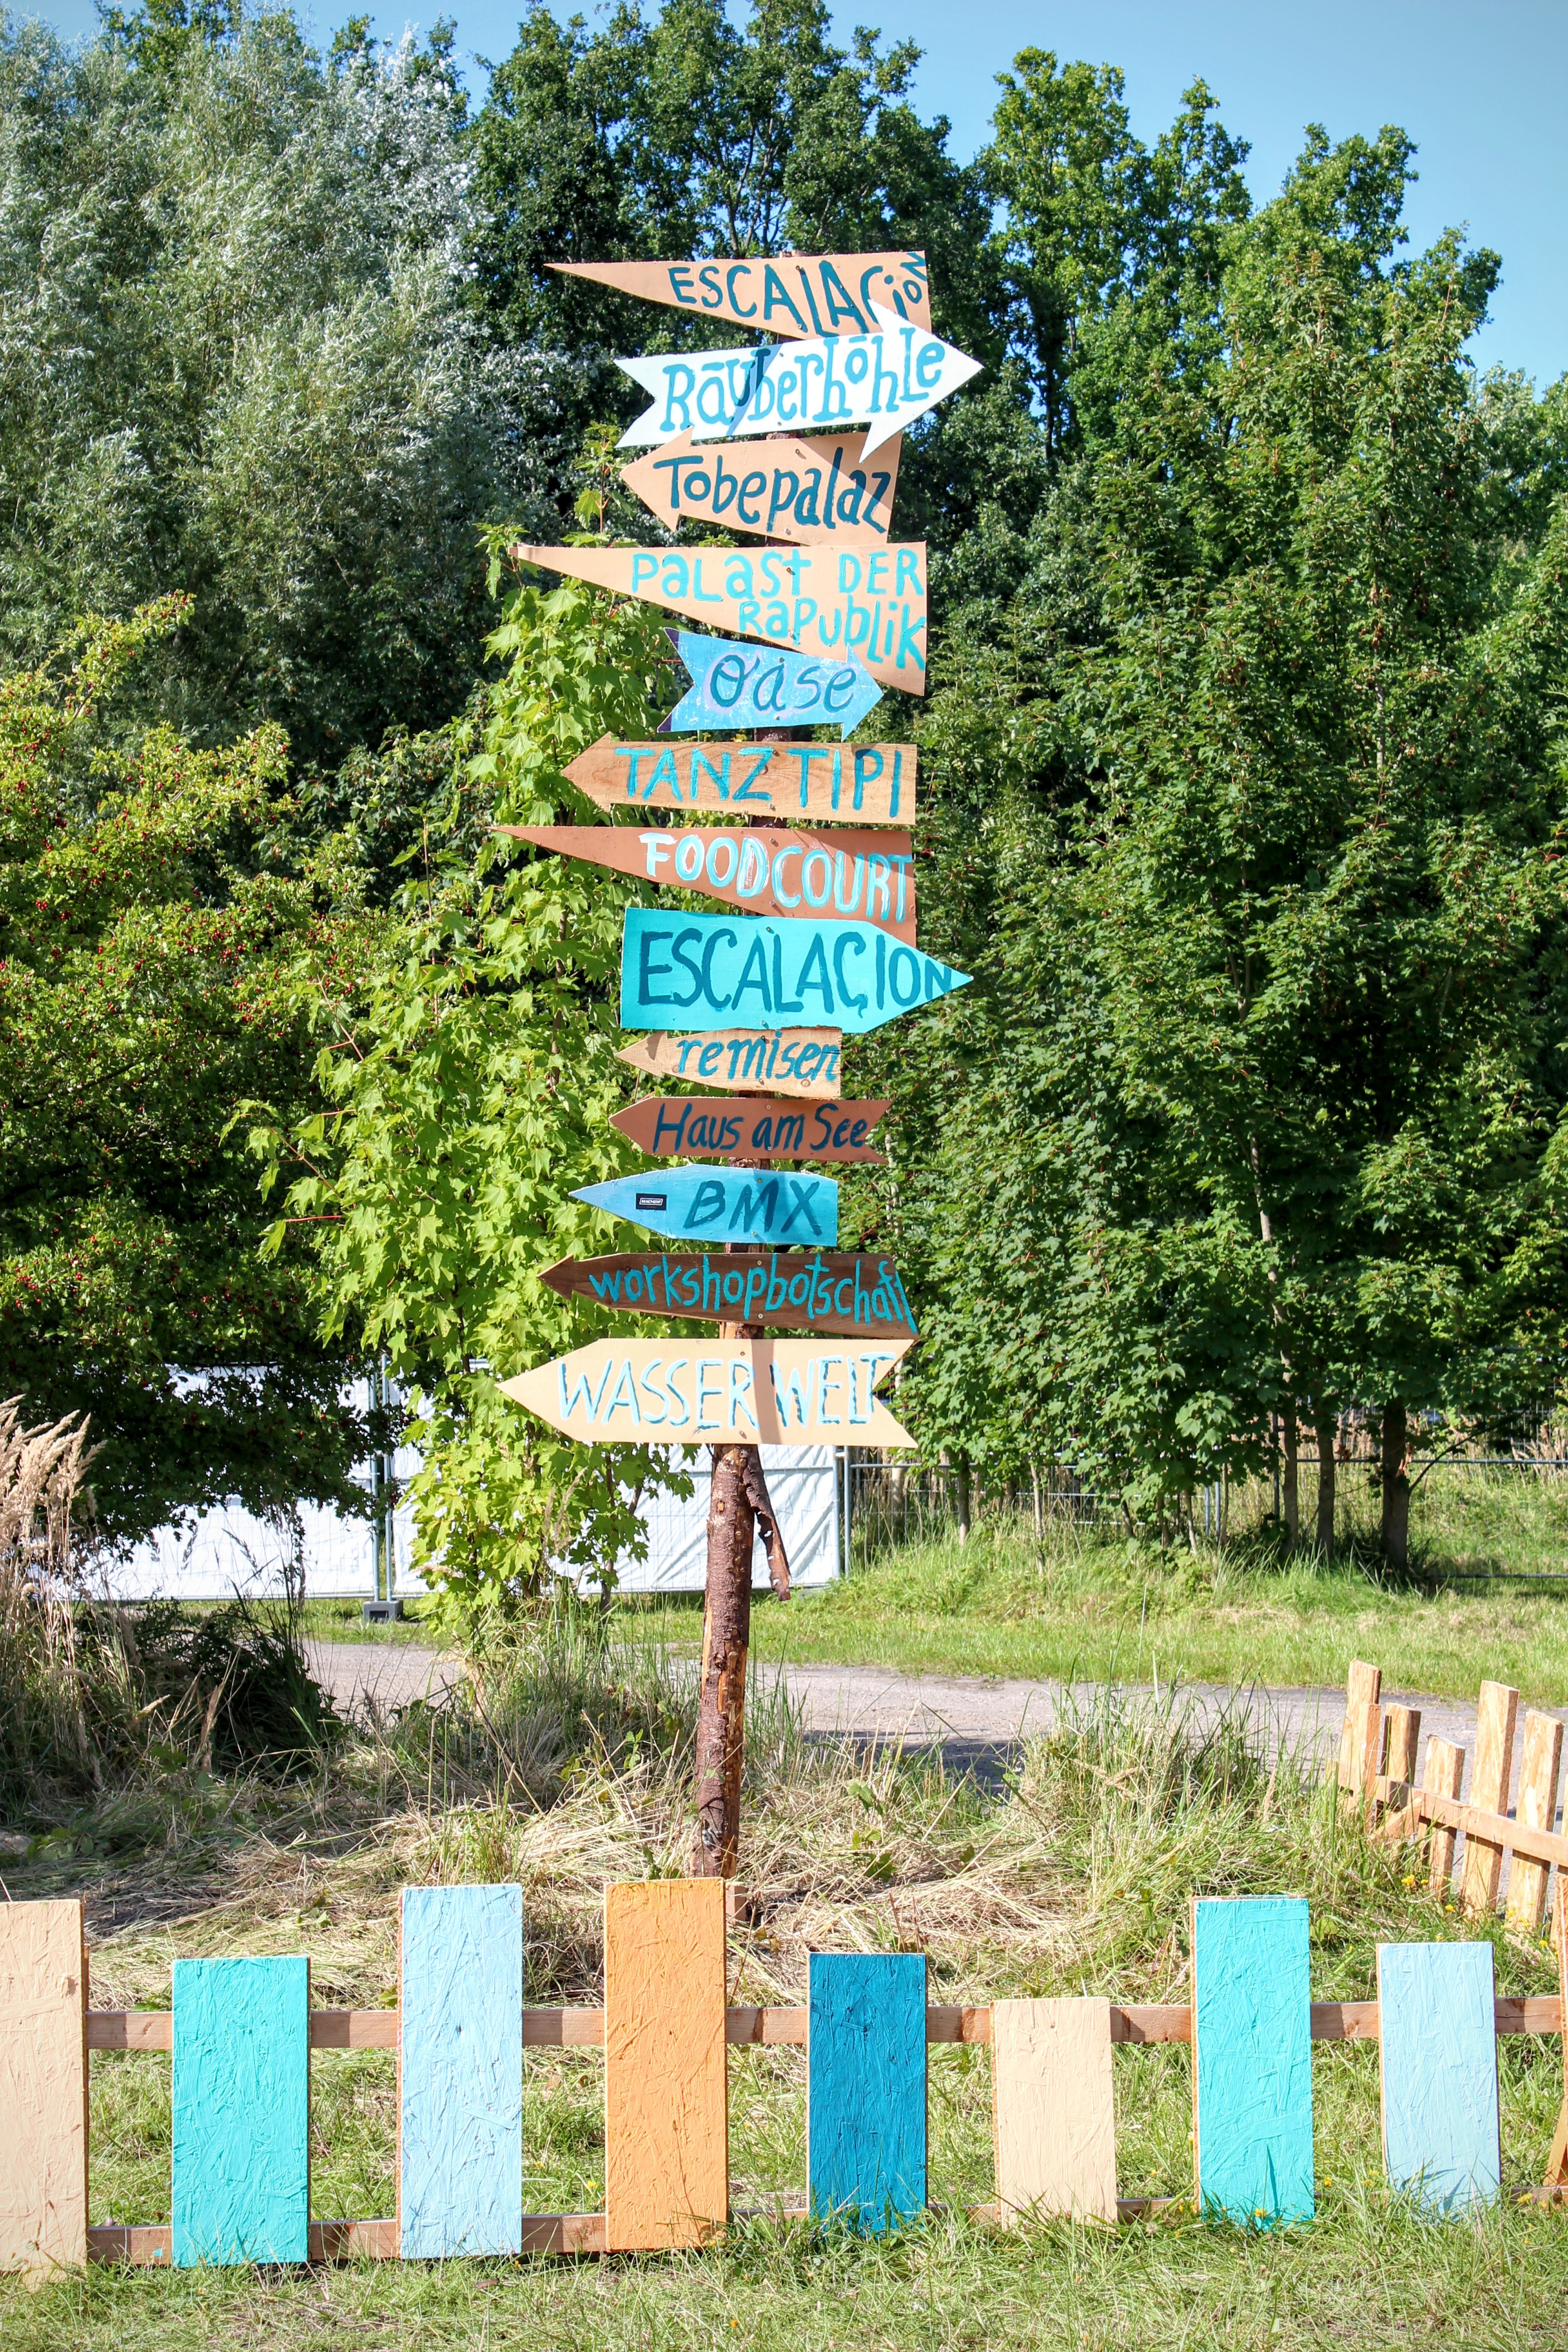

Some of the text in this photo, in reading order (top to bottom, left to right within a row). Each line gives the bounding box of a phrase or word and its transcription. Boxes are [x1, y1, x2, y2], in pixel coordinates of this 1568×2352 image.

[838, 548, 924, 597] DER
[652, 1102, 868, 1152] Haus am See
[683, 1179, 823, 1236] BMX
